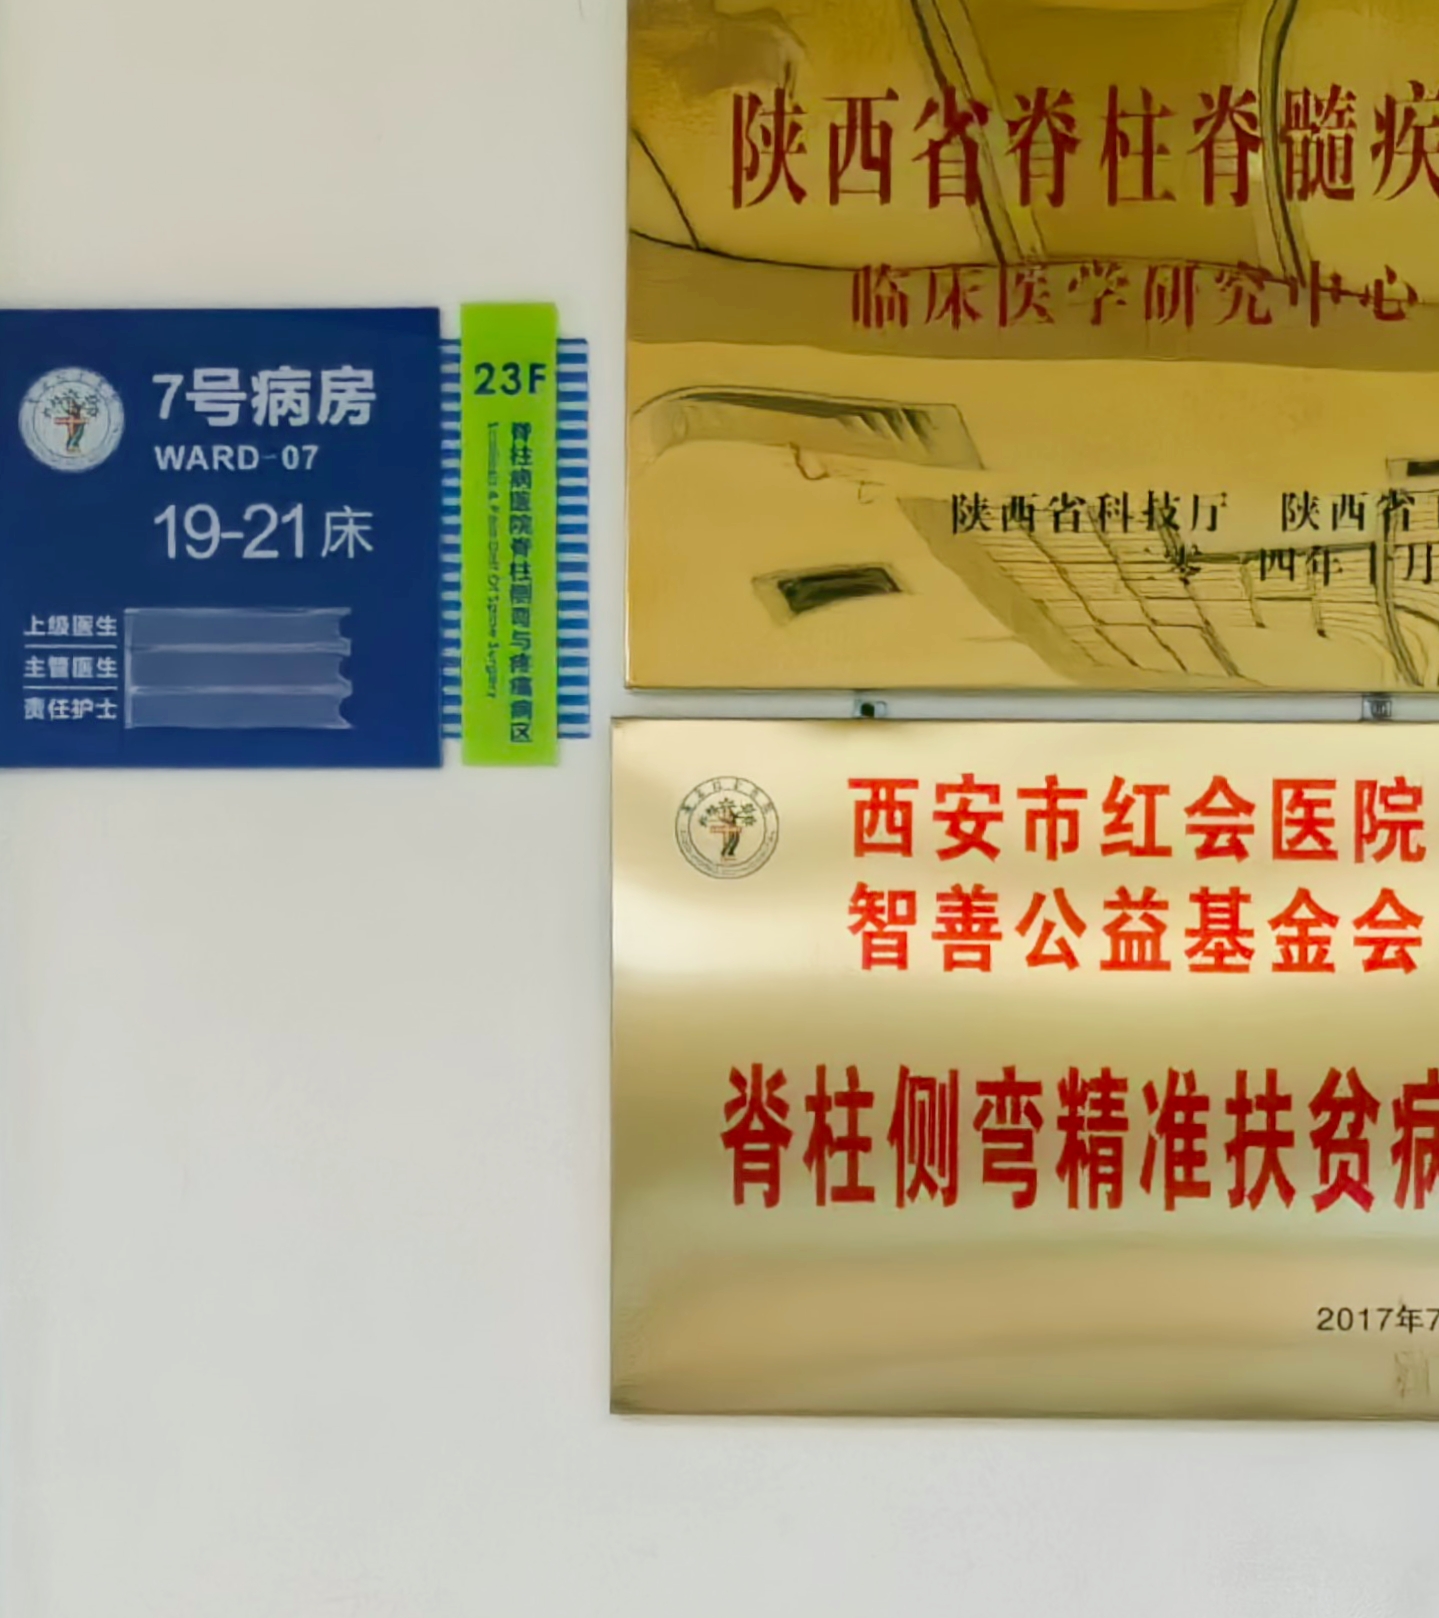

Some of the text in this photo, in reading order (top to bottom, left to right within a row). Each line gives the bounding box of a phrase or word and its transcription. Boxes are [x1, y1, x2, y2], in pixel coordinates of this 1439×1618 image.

[849, 260, 1421, 333] 临床医学研究中心
[151, 366, 376, 428] 7号病房
[474, 362, 547, 395] 23F
[951, 491, 1228, 534] 陕西省科技厅
[23, 615, 118, 636] 上级医生
[23, 656, 118, 678] 主管医生
[24, 697, 118, 720] 责任护士
[847, 773, 1427, 865] 西安市红会医院
[847, 882, 1425, 975] 智善公益基金会
